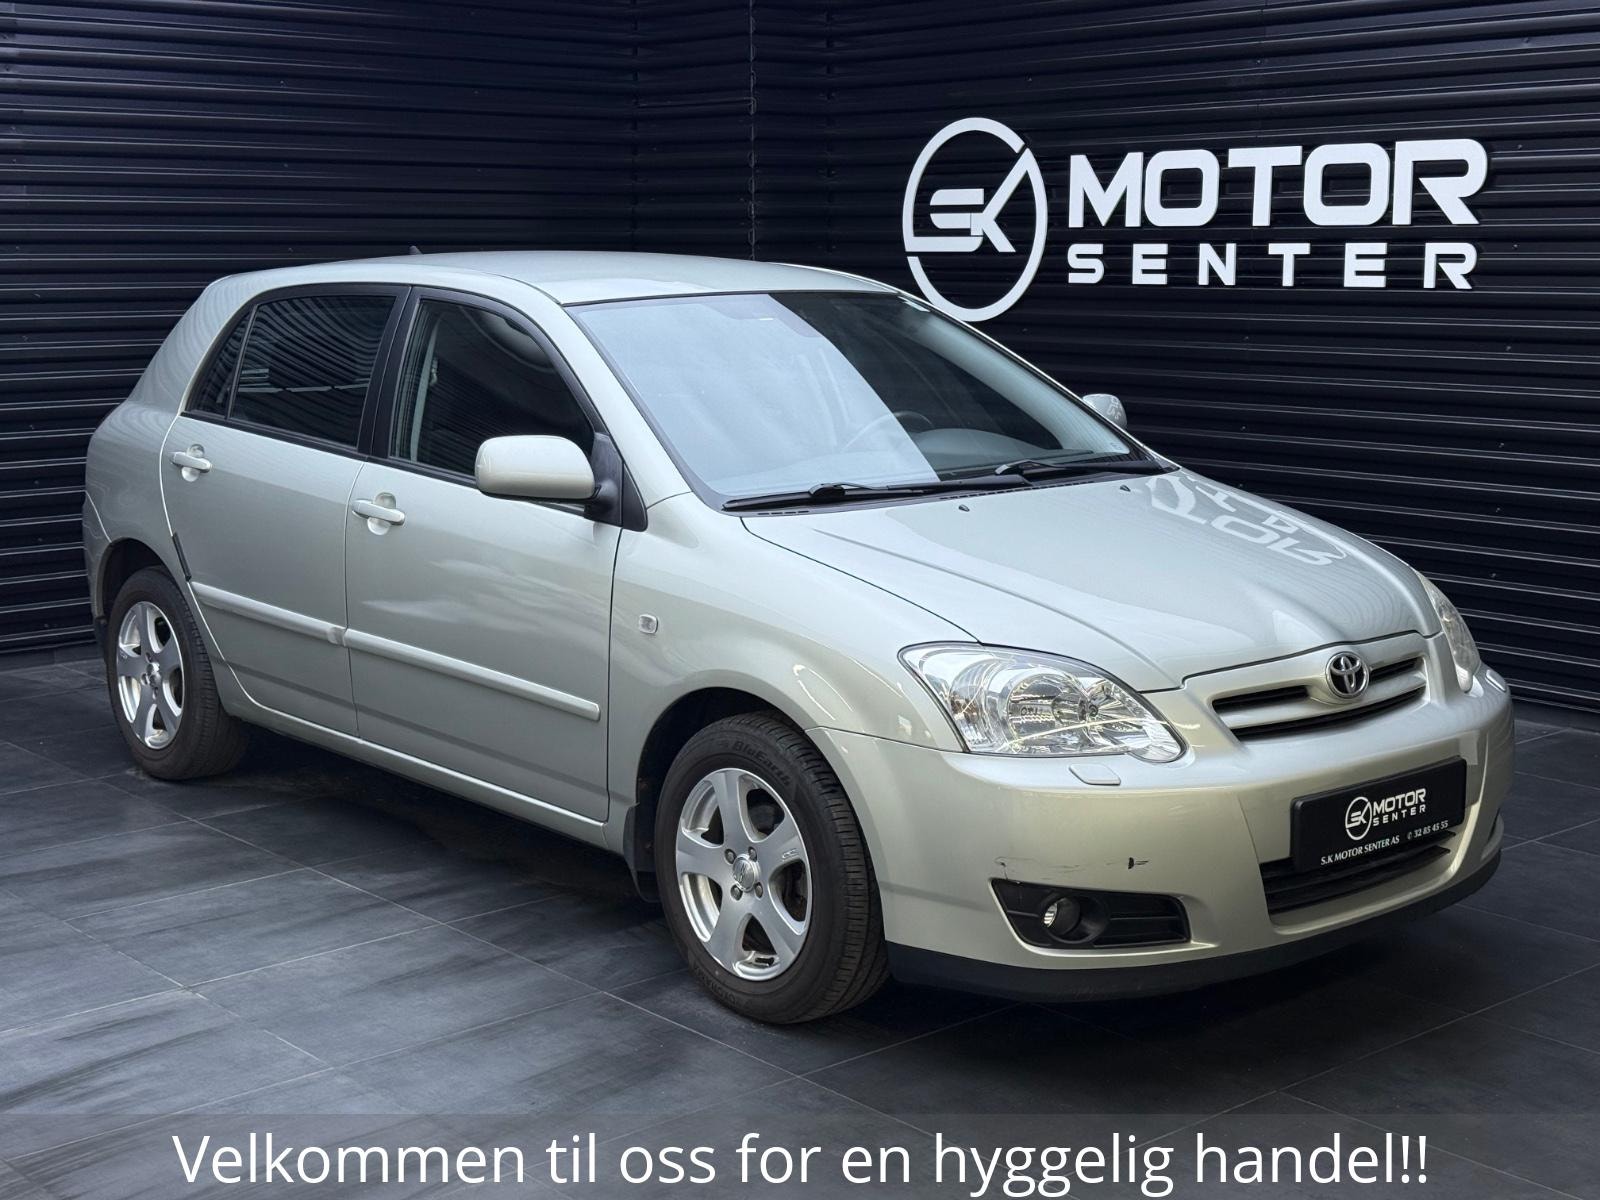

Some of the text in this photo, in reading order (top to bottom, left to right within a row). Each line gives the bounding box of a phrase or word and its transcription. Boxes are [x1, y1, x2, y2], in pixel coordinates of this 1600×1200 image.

[1068, 138, 1488, 228] MOTOR
[1068, 242, 1478, 290] SENTER
[1373, 788, 1427, 816] MOTOR
[1373, 804, 1427, 827] SENTER
[1334, 846, 1363, 862] MOTOR
[1364, 838, 1391, 853] SENTER
[1391, 835, 1400, 845] AS
